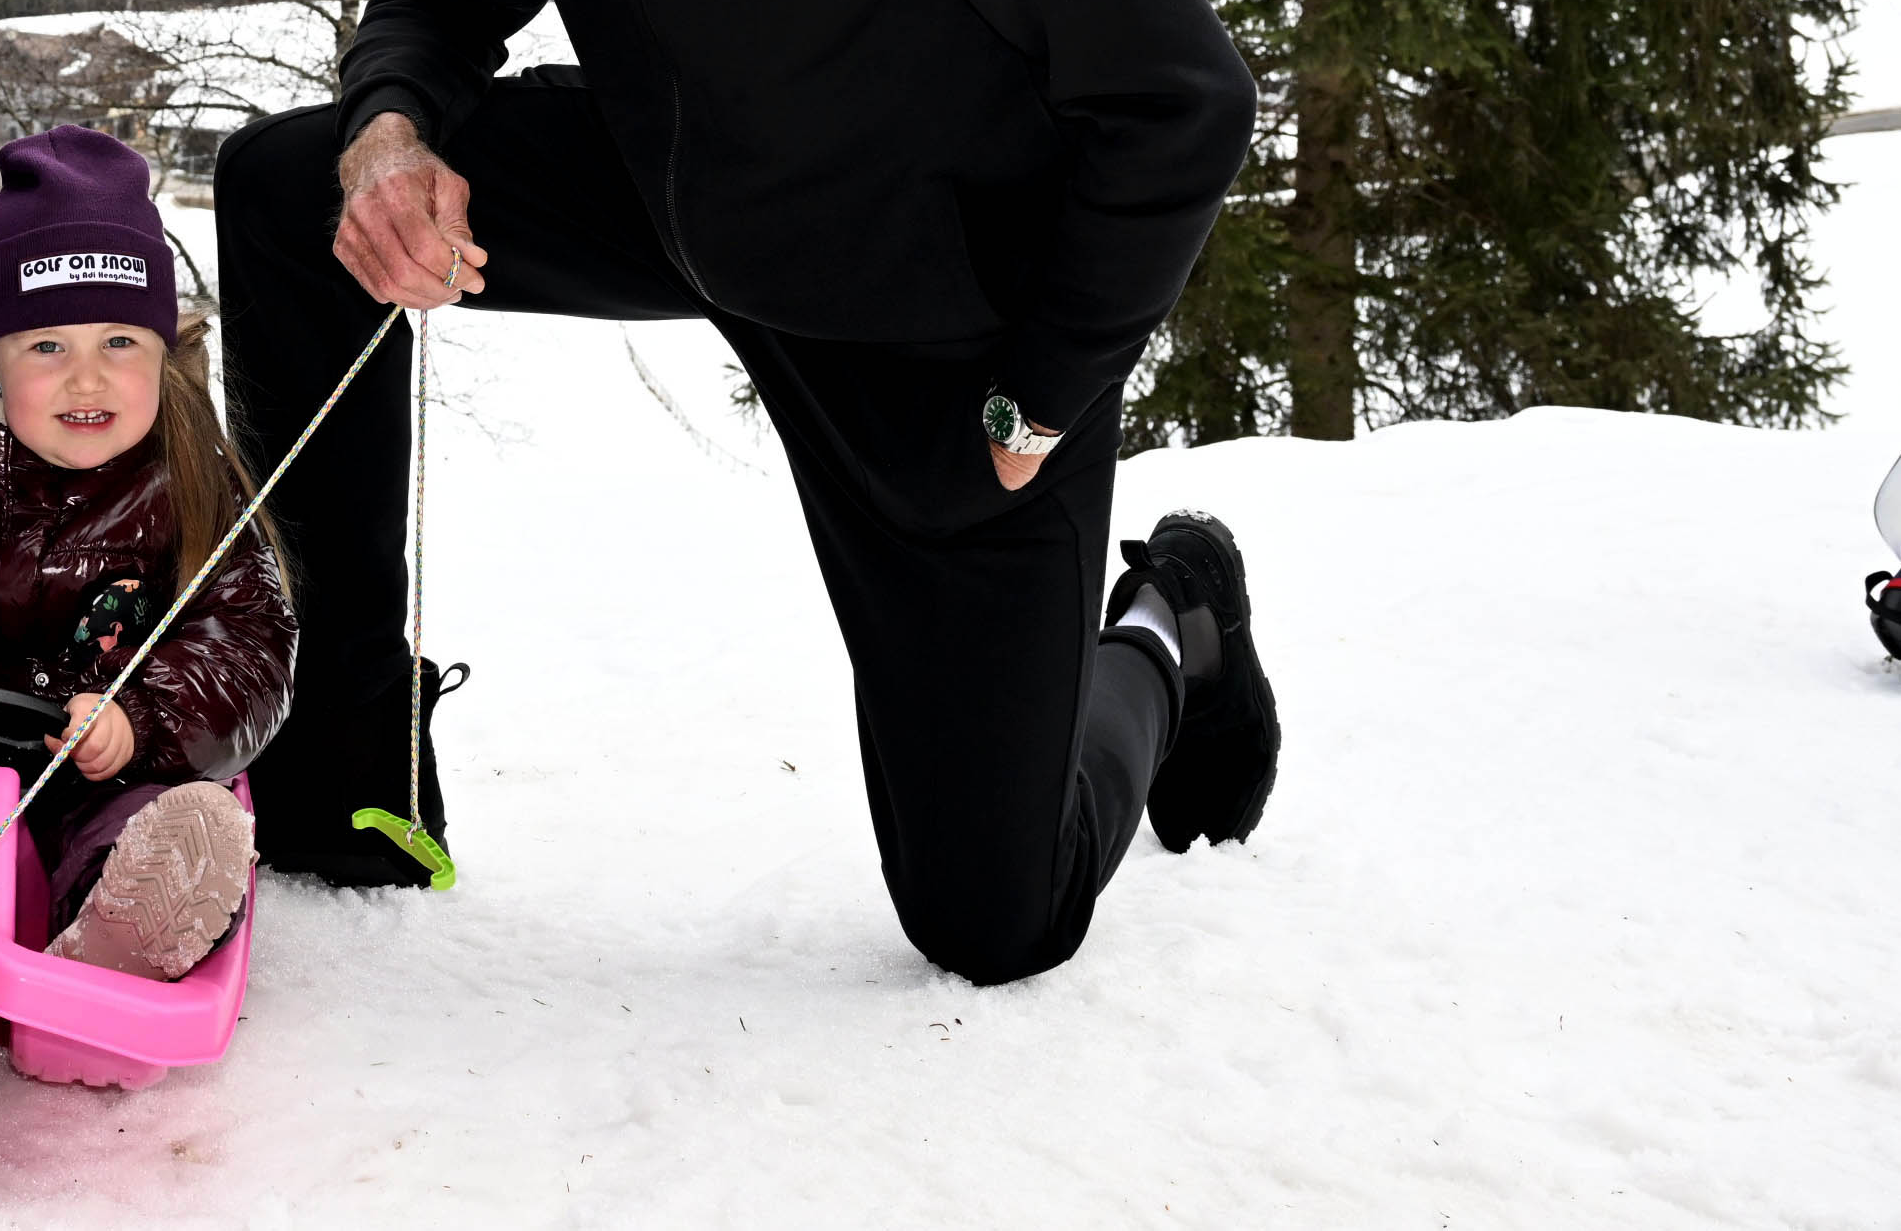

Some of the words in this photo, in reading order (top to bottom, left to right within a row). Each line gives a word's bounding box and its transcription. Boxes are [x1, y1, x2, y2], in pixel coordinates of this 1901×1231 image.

[23, 257, 63, 277] GOLF
[69, 255, 95, 270] ON
[101, 255, 144, 273] SNOW
[69, 273, 80, 281] by
[98, 272, 145, 283] Hengstberger
